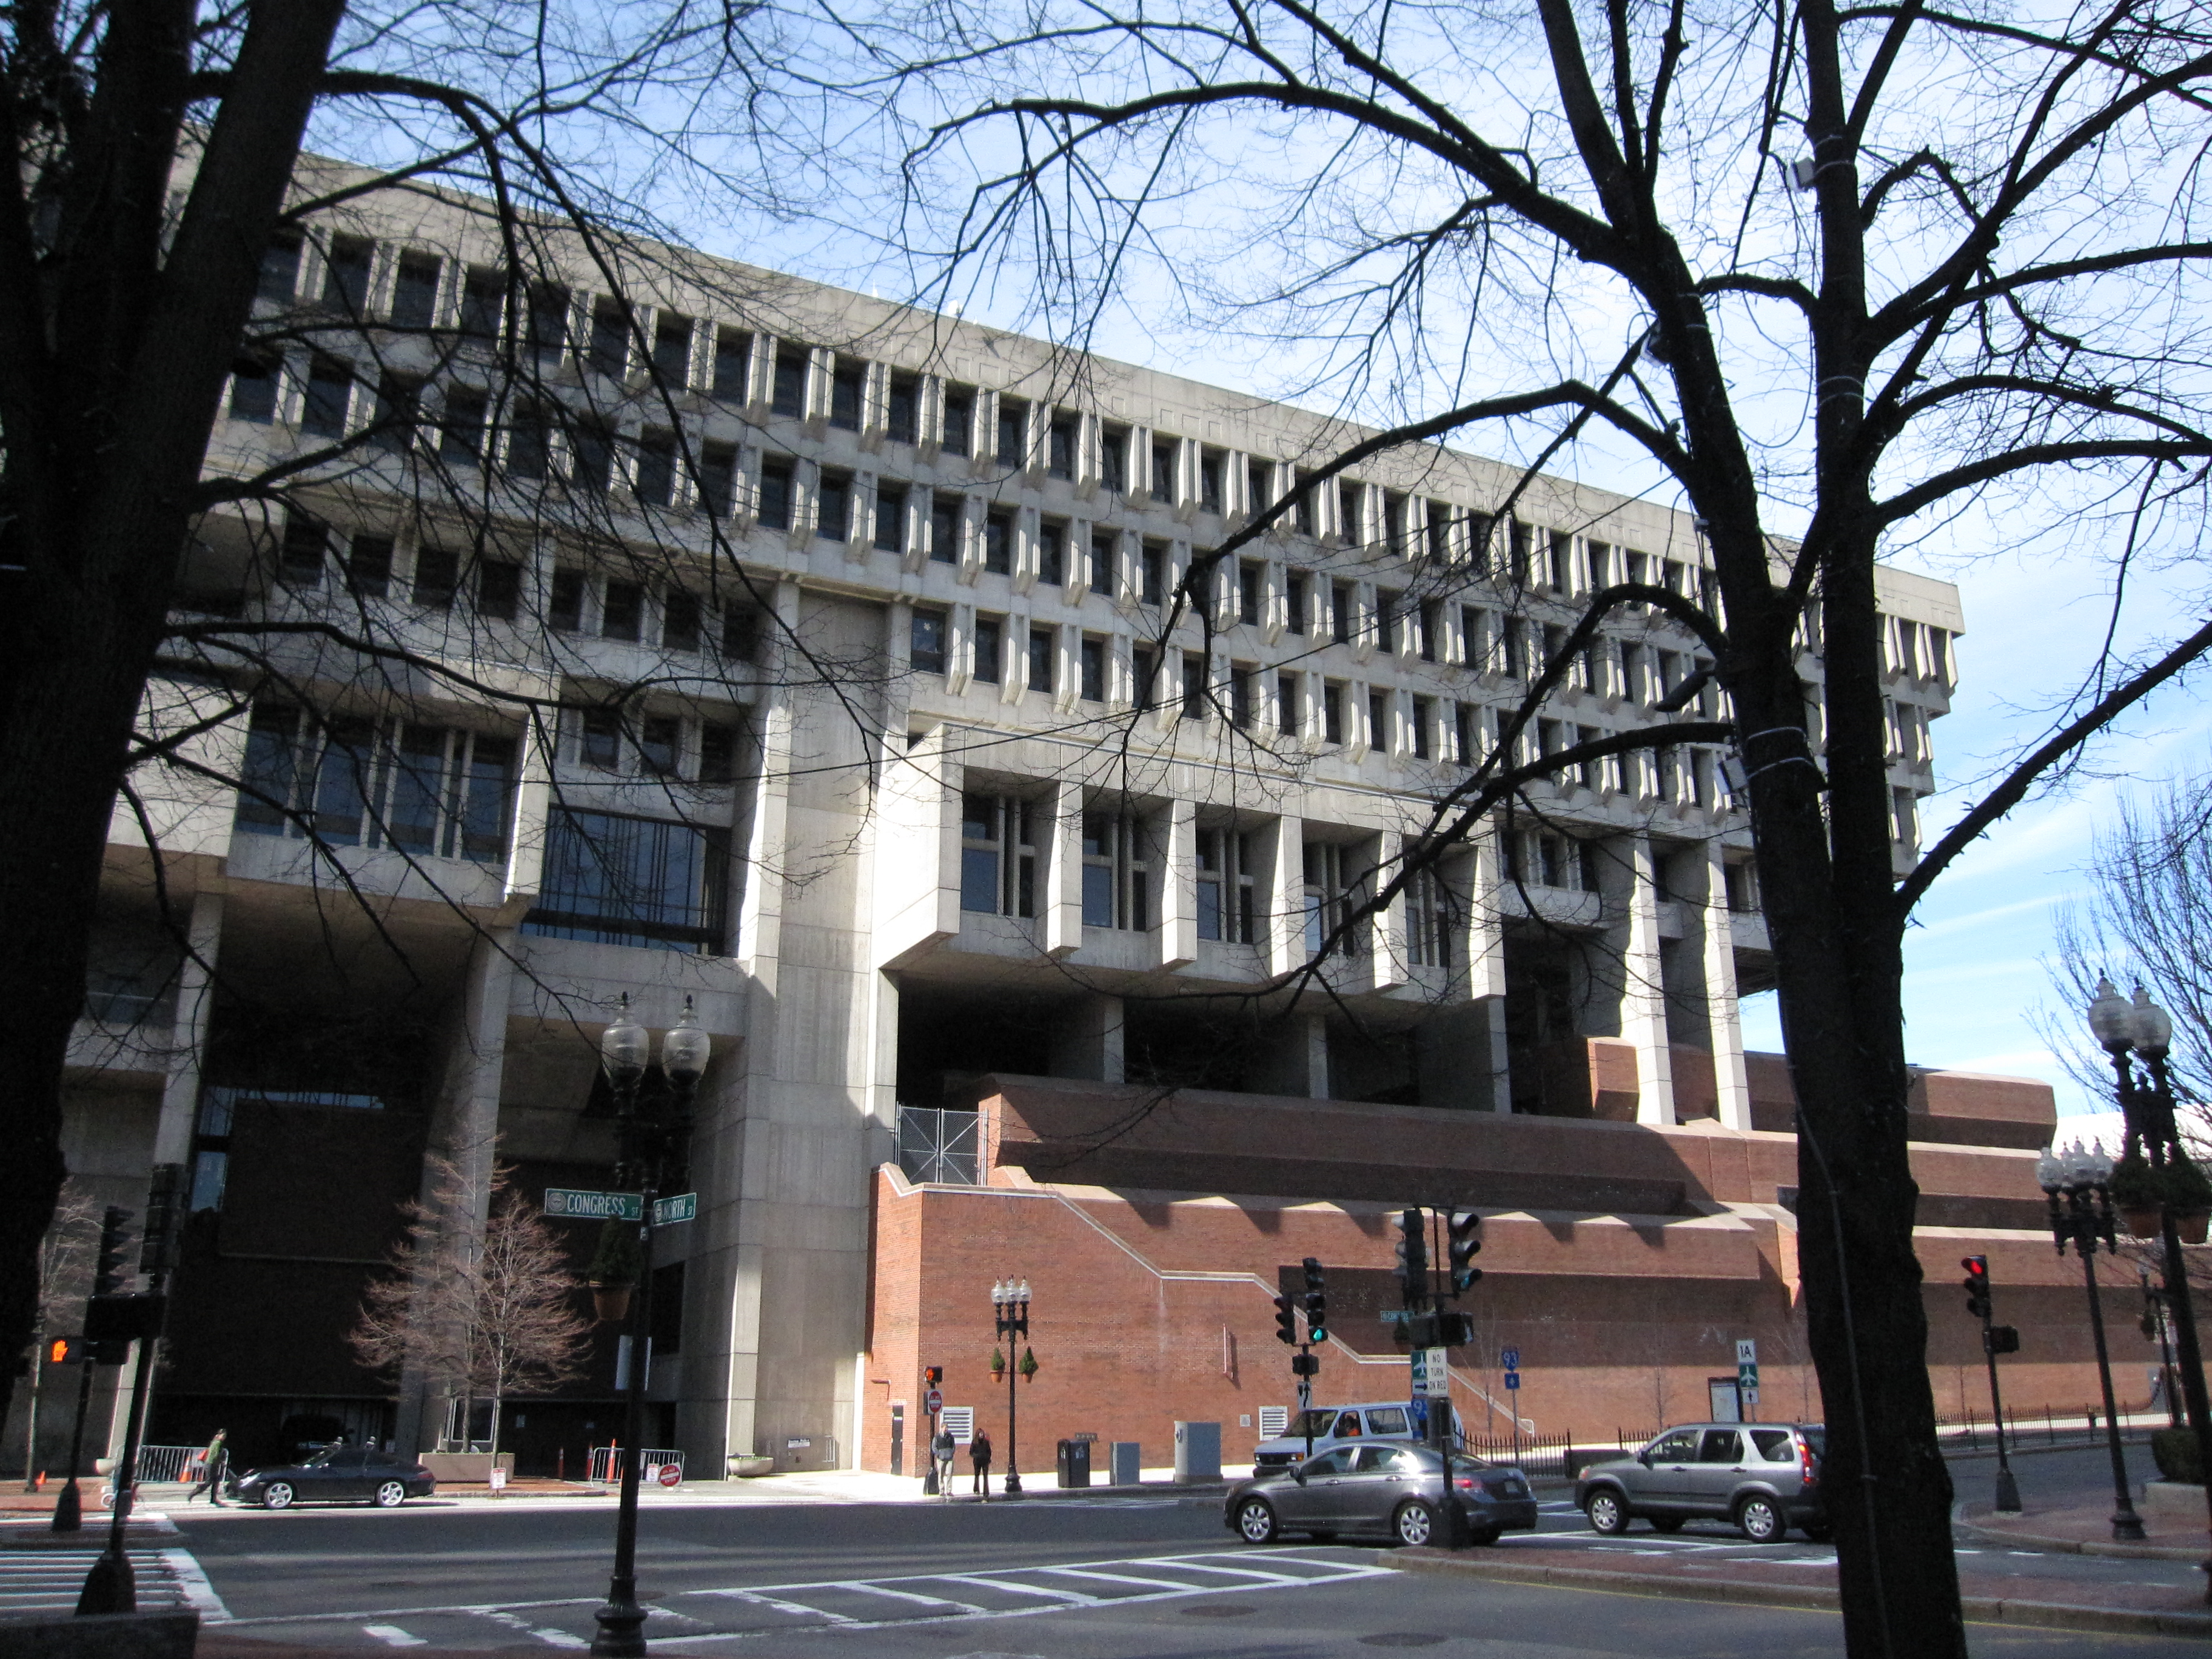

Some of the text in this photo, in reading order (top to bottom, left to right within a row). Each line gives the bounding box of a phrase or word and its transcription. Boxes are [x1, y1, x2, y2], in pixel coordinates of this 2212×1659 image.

[567, 1193, 638, 1216] CONGRESS ST
[662, 1199, 686, 1220] NORTH
[1740, 1345, 1752, 1358] 1A
[1432, 1354, 1441, 1363] NO
[1504, 1352, 1517, 1367] 93
[1430, 1367, 1444, 1376] TURN
[1429, 1380, 1447, 1390] ON RED
